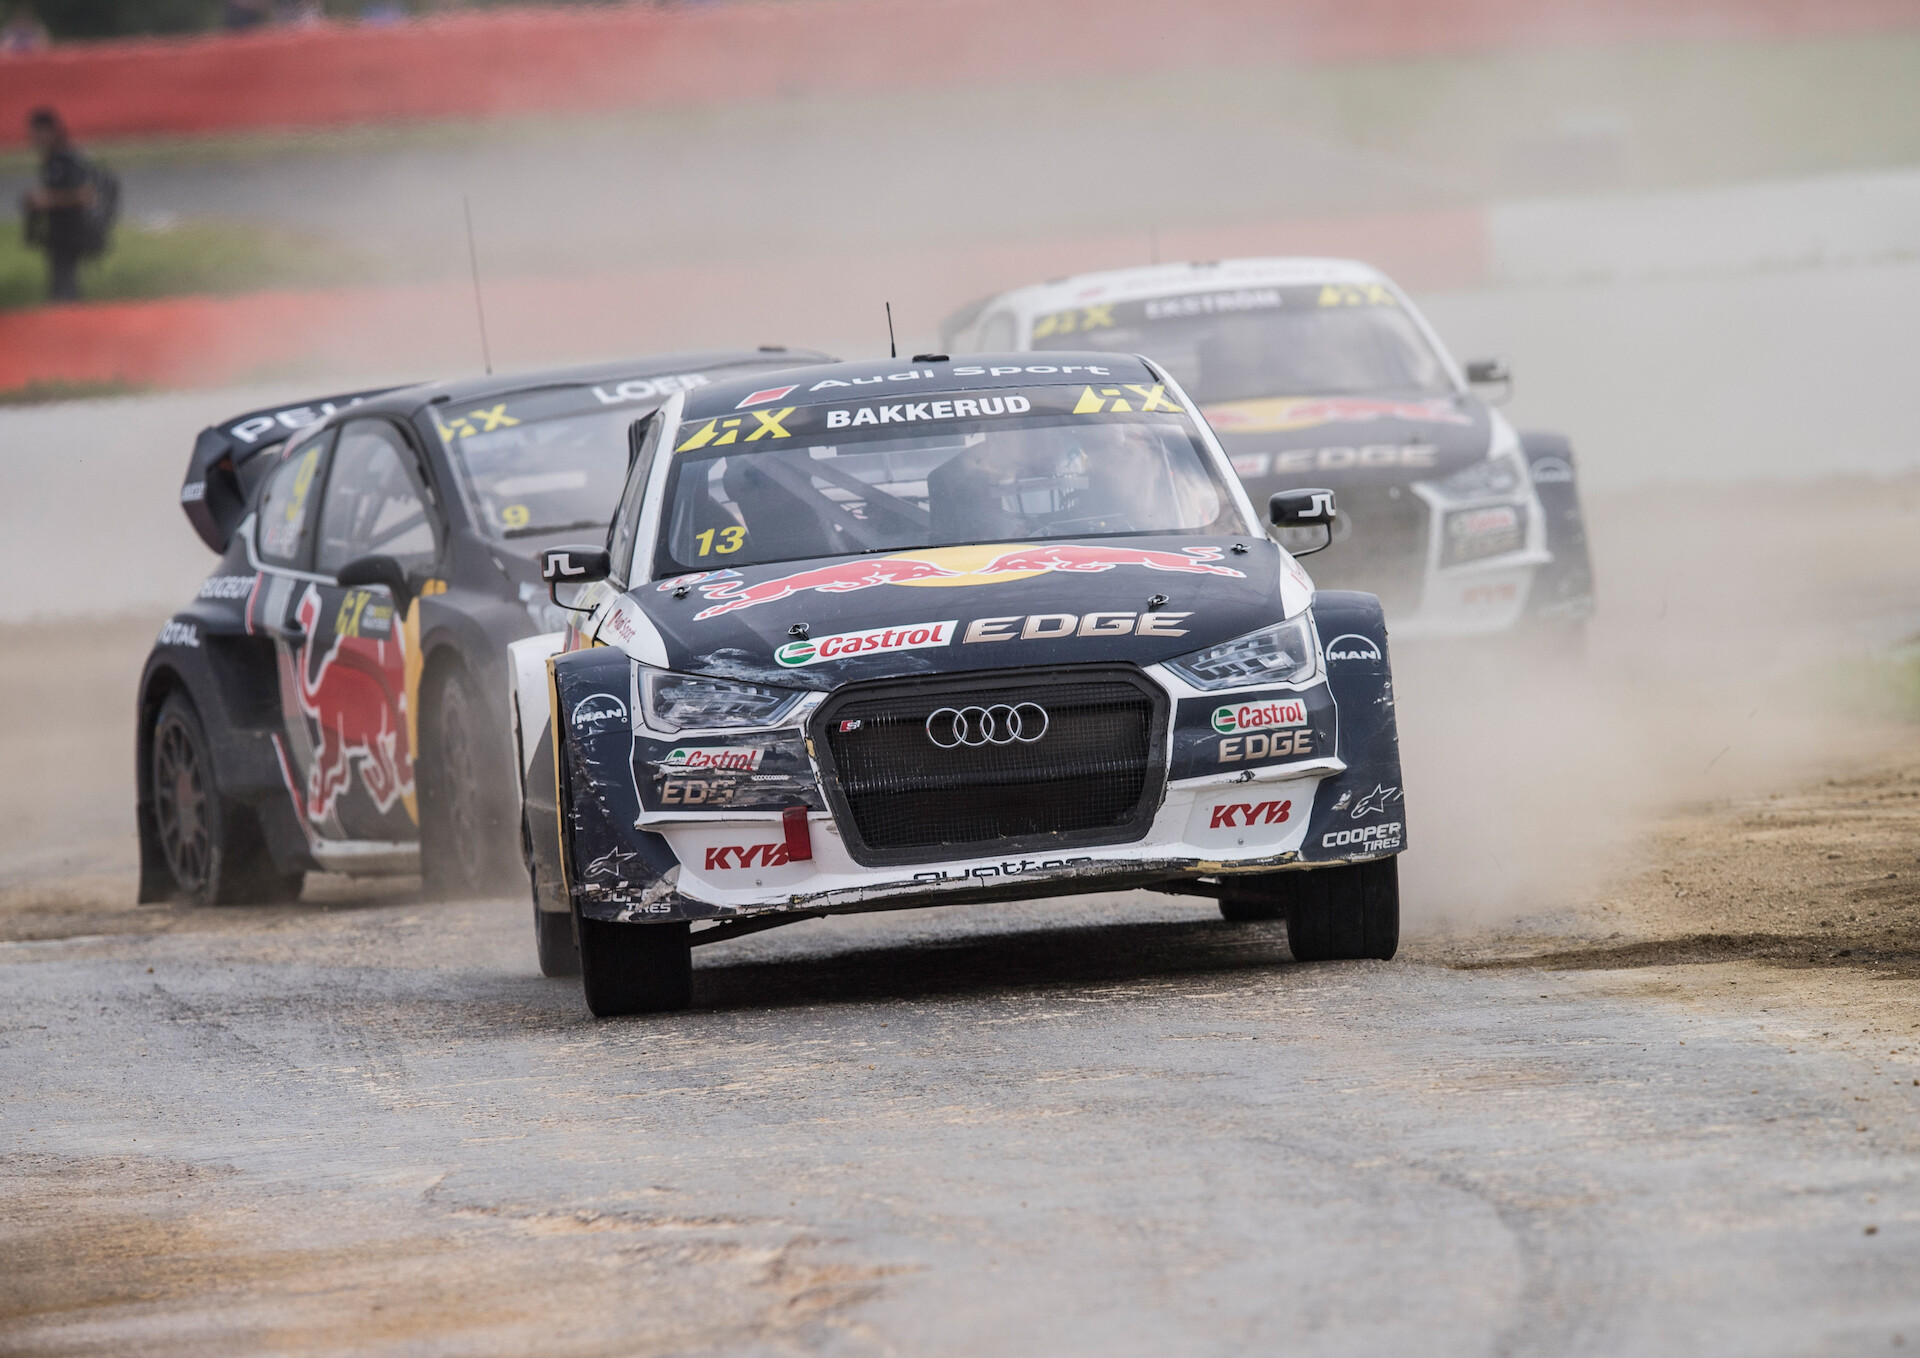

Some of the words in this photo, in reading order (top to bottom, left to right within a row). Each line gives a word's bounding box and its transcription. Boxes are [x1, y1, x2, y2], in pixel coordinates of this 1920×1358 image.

[808, 367, 934, 392] Audi
[952, 365, 1110, 379] Sport
[826, 395, 1031, 429] BAKKERUD
[1274, 443, 1437, 474] EDGE
[502, 504, 530, 529] 9
[695, 526, 745, 557] 13
[819, 624, 943, 658] Castrol
[962, 611, 1195, 645] EDGE
[1329, 650, 1377, 661] MAN
[575, 708, 622, 724] MAN
[1237, 702, 1304, 729] Castrol
[1218, 729, 1314, 764] EDGE
[686, 750, 758, 771] Castrol
[1209, 799, 1292, 829] KYB
[1322, 822, 1402, 849] COOPER
[1362, 837, 1401, 852] TIRES
